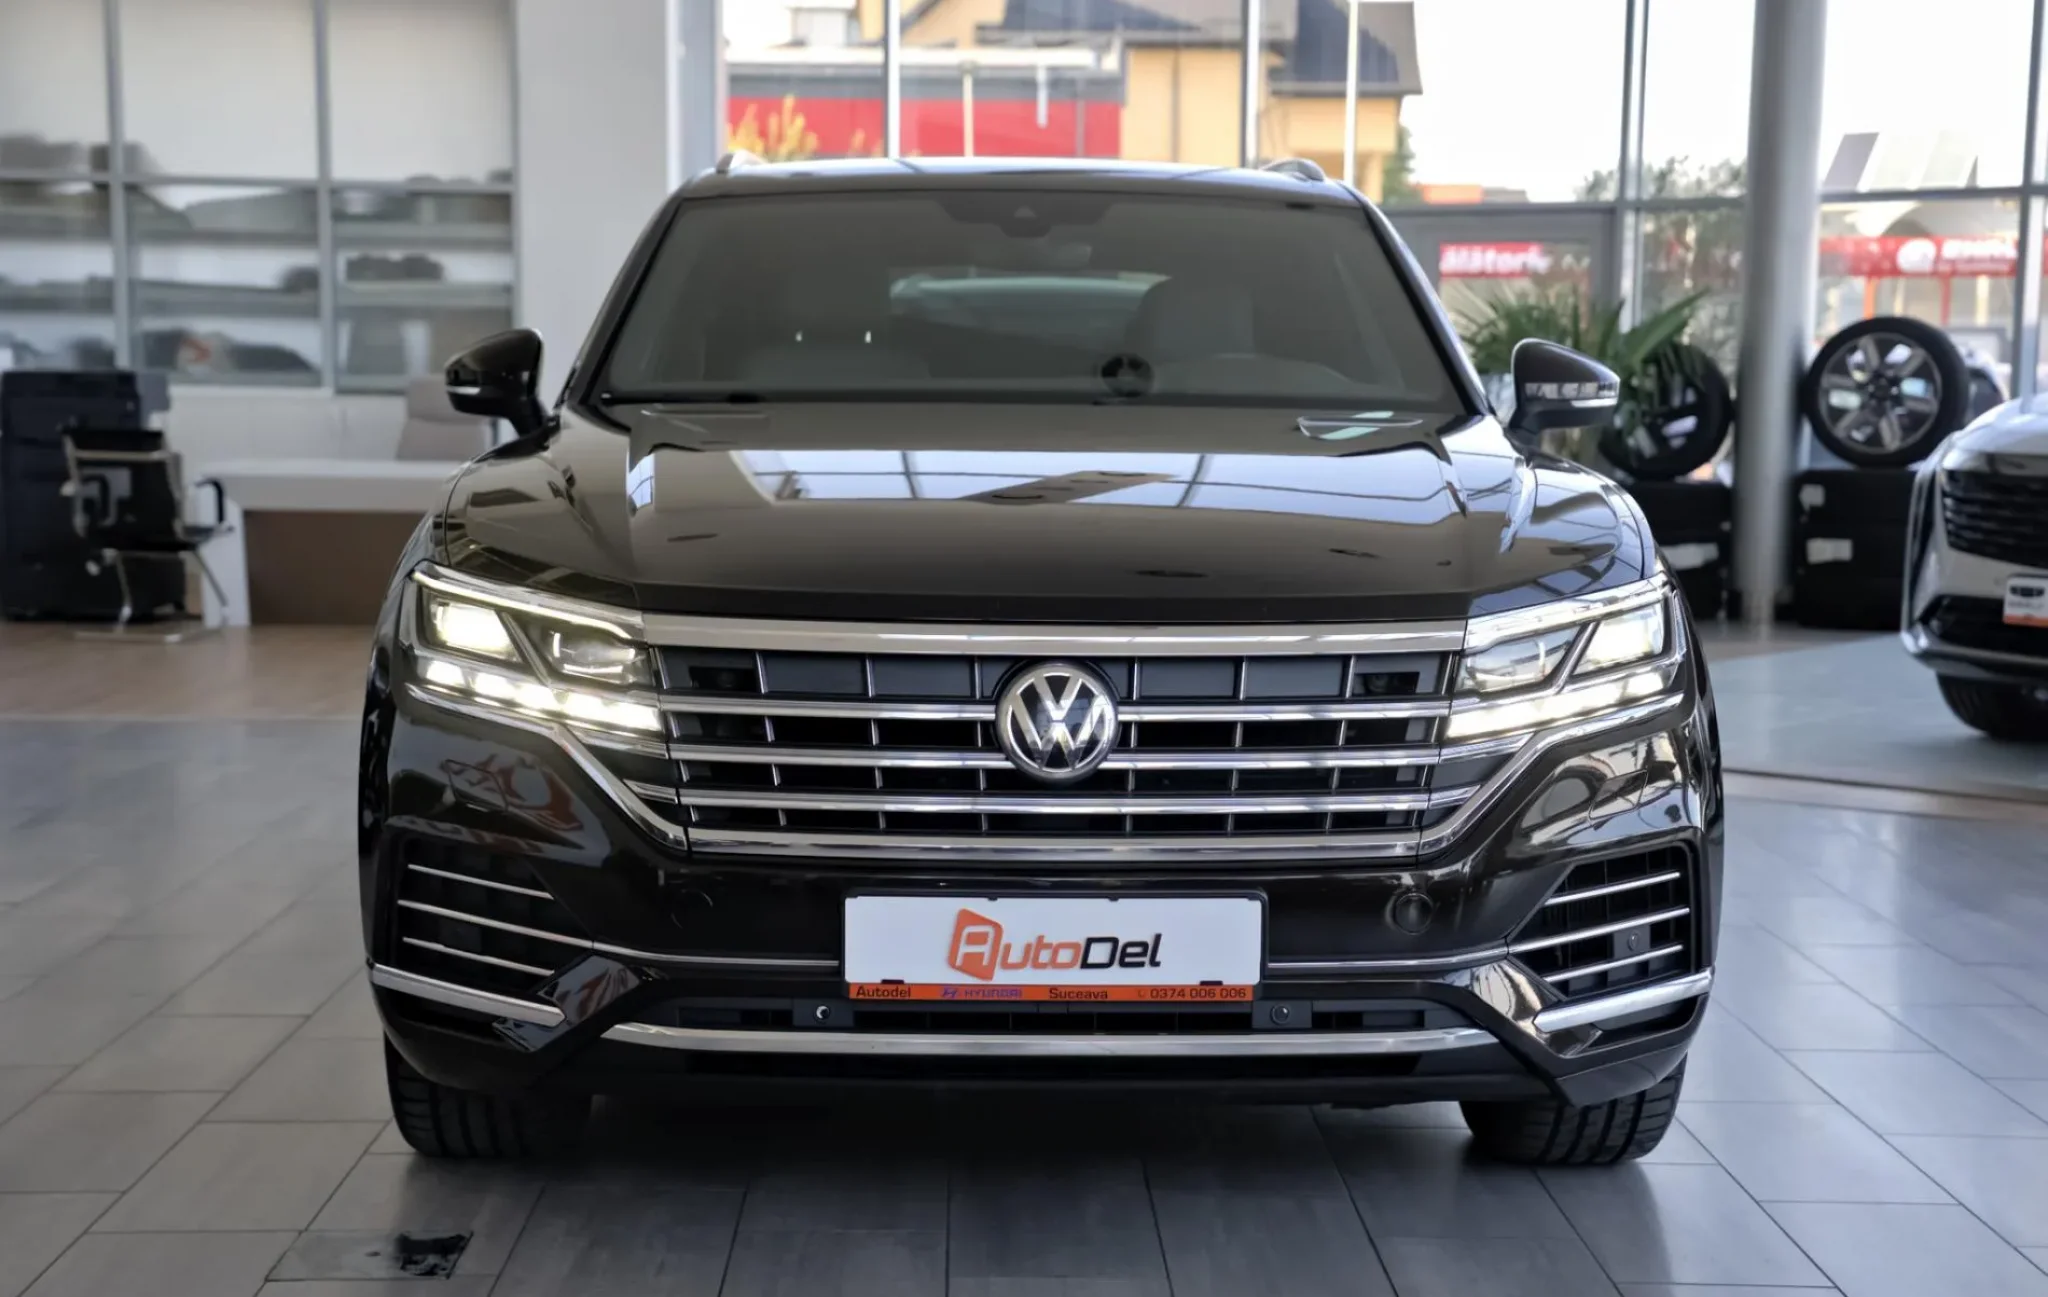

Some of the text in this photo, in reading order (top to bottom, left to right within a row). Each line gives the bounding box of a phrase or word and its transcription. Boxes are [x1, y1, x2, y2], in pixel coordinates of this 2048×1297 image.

[1003, 667, 1113, 776] VW
[948, 909, 1161, 980] AutoDel
[856, 986, 1247, 999] Autodel HYUNDAI Suceava 0374 006 006
